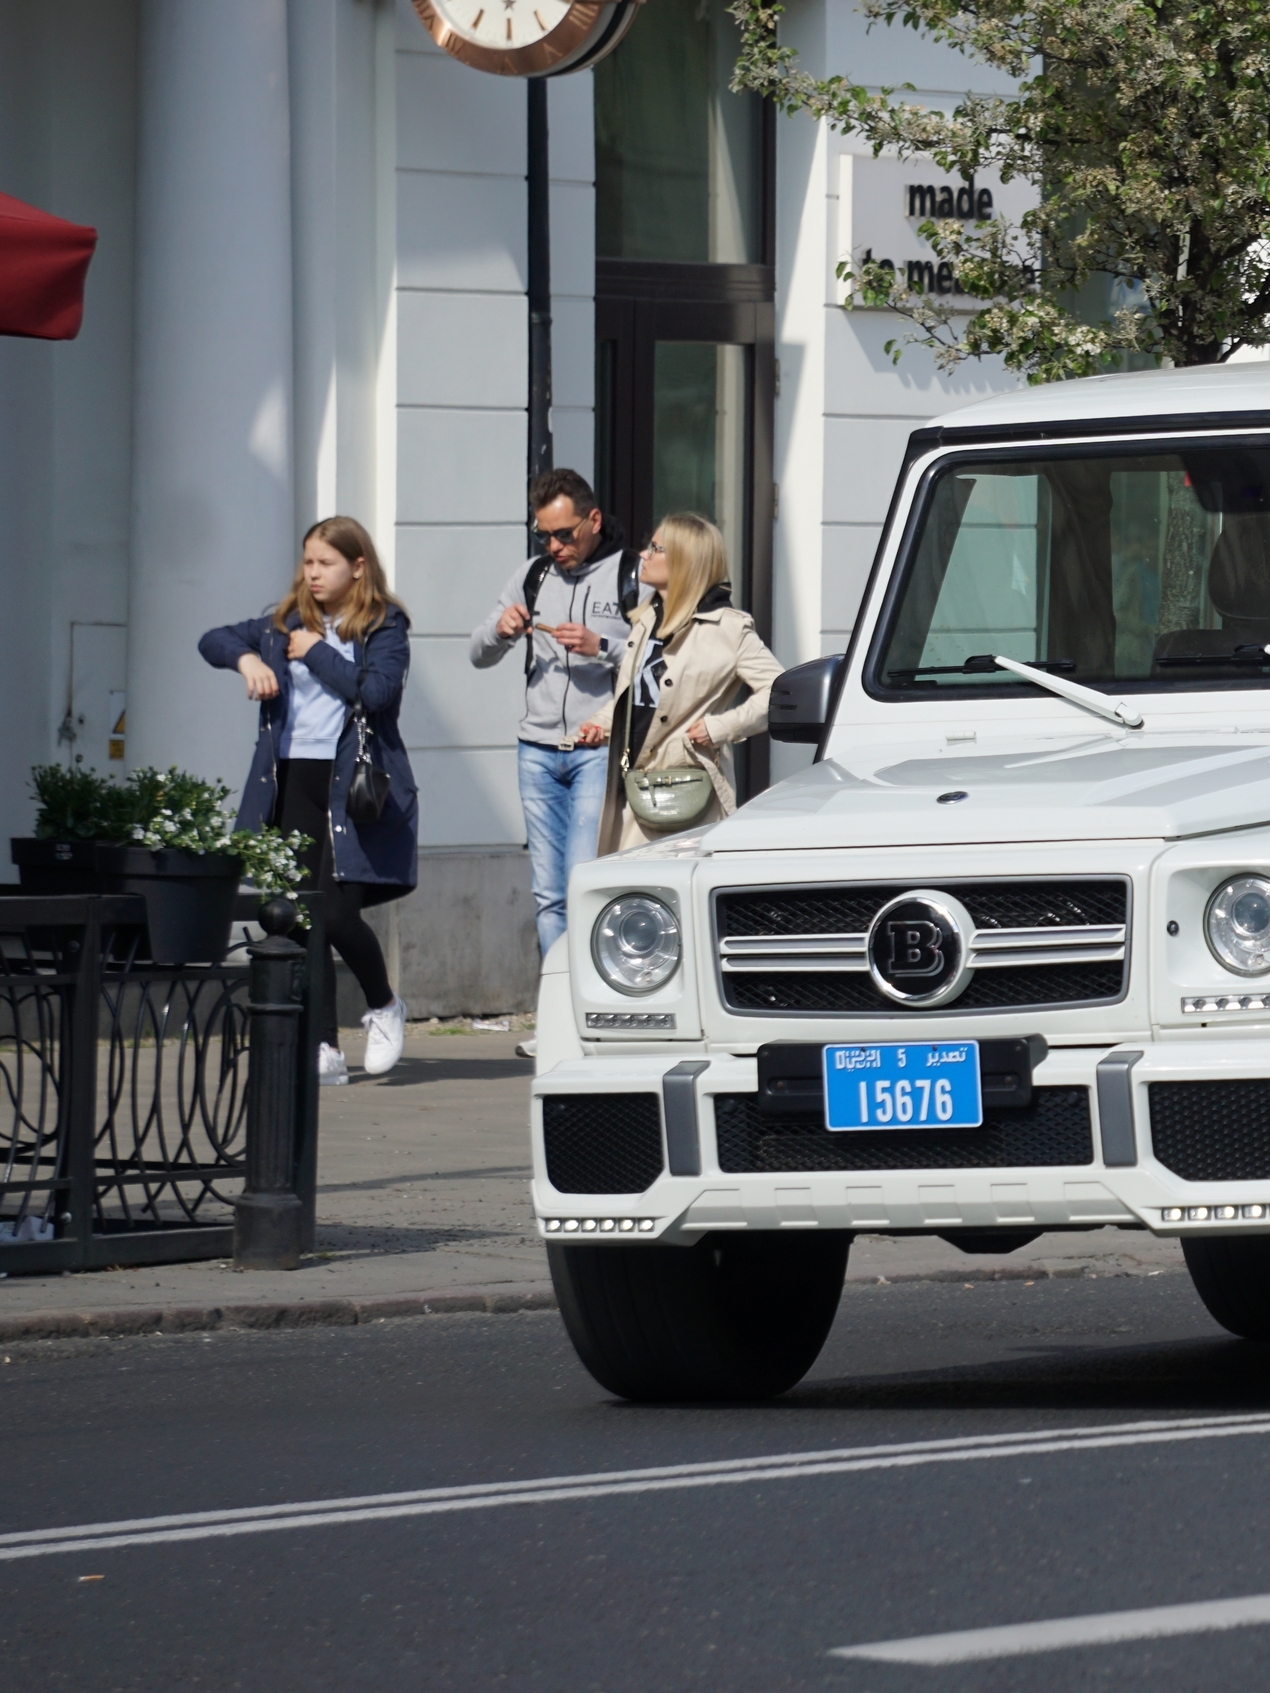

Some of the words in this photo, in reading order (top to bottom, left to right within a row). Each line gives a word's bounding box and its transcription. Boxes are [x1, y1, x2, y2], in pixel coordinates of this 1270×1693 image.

[906, 172, 993, 220] made
[888, 920, 944, 977] B
[898, 1048, 907, 1068] 5
[858, 1078, 953, 1123] 15676
